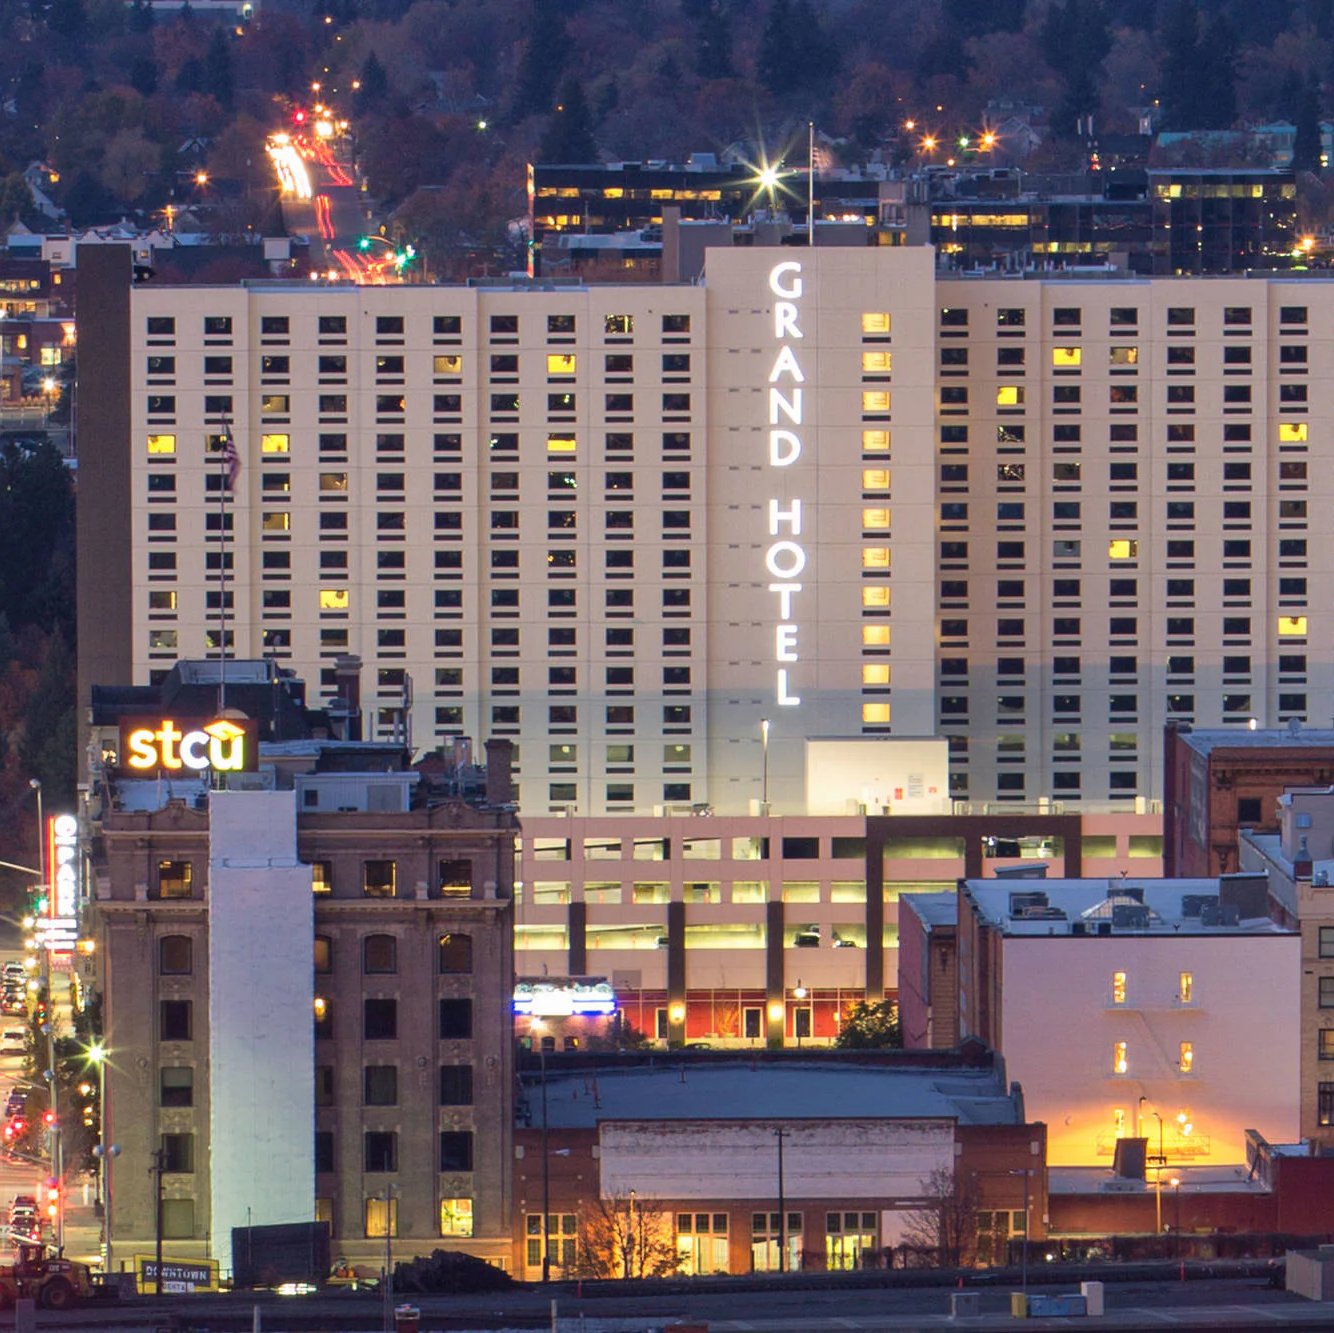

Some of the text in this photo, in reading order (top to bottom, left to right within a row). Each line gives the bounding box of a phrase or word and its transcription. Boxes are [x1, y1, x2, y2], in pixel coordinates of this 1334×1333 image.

[766, 261, 805, 705] GRAND HOTEL
[128, 719, 246, 770] stcu
